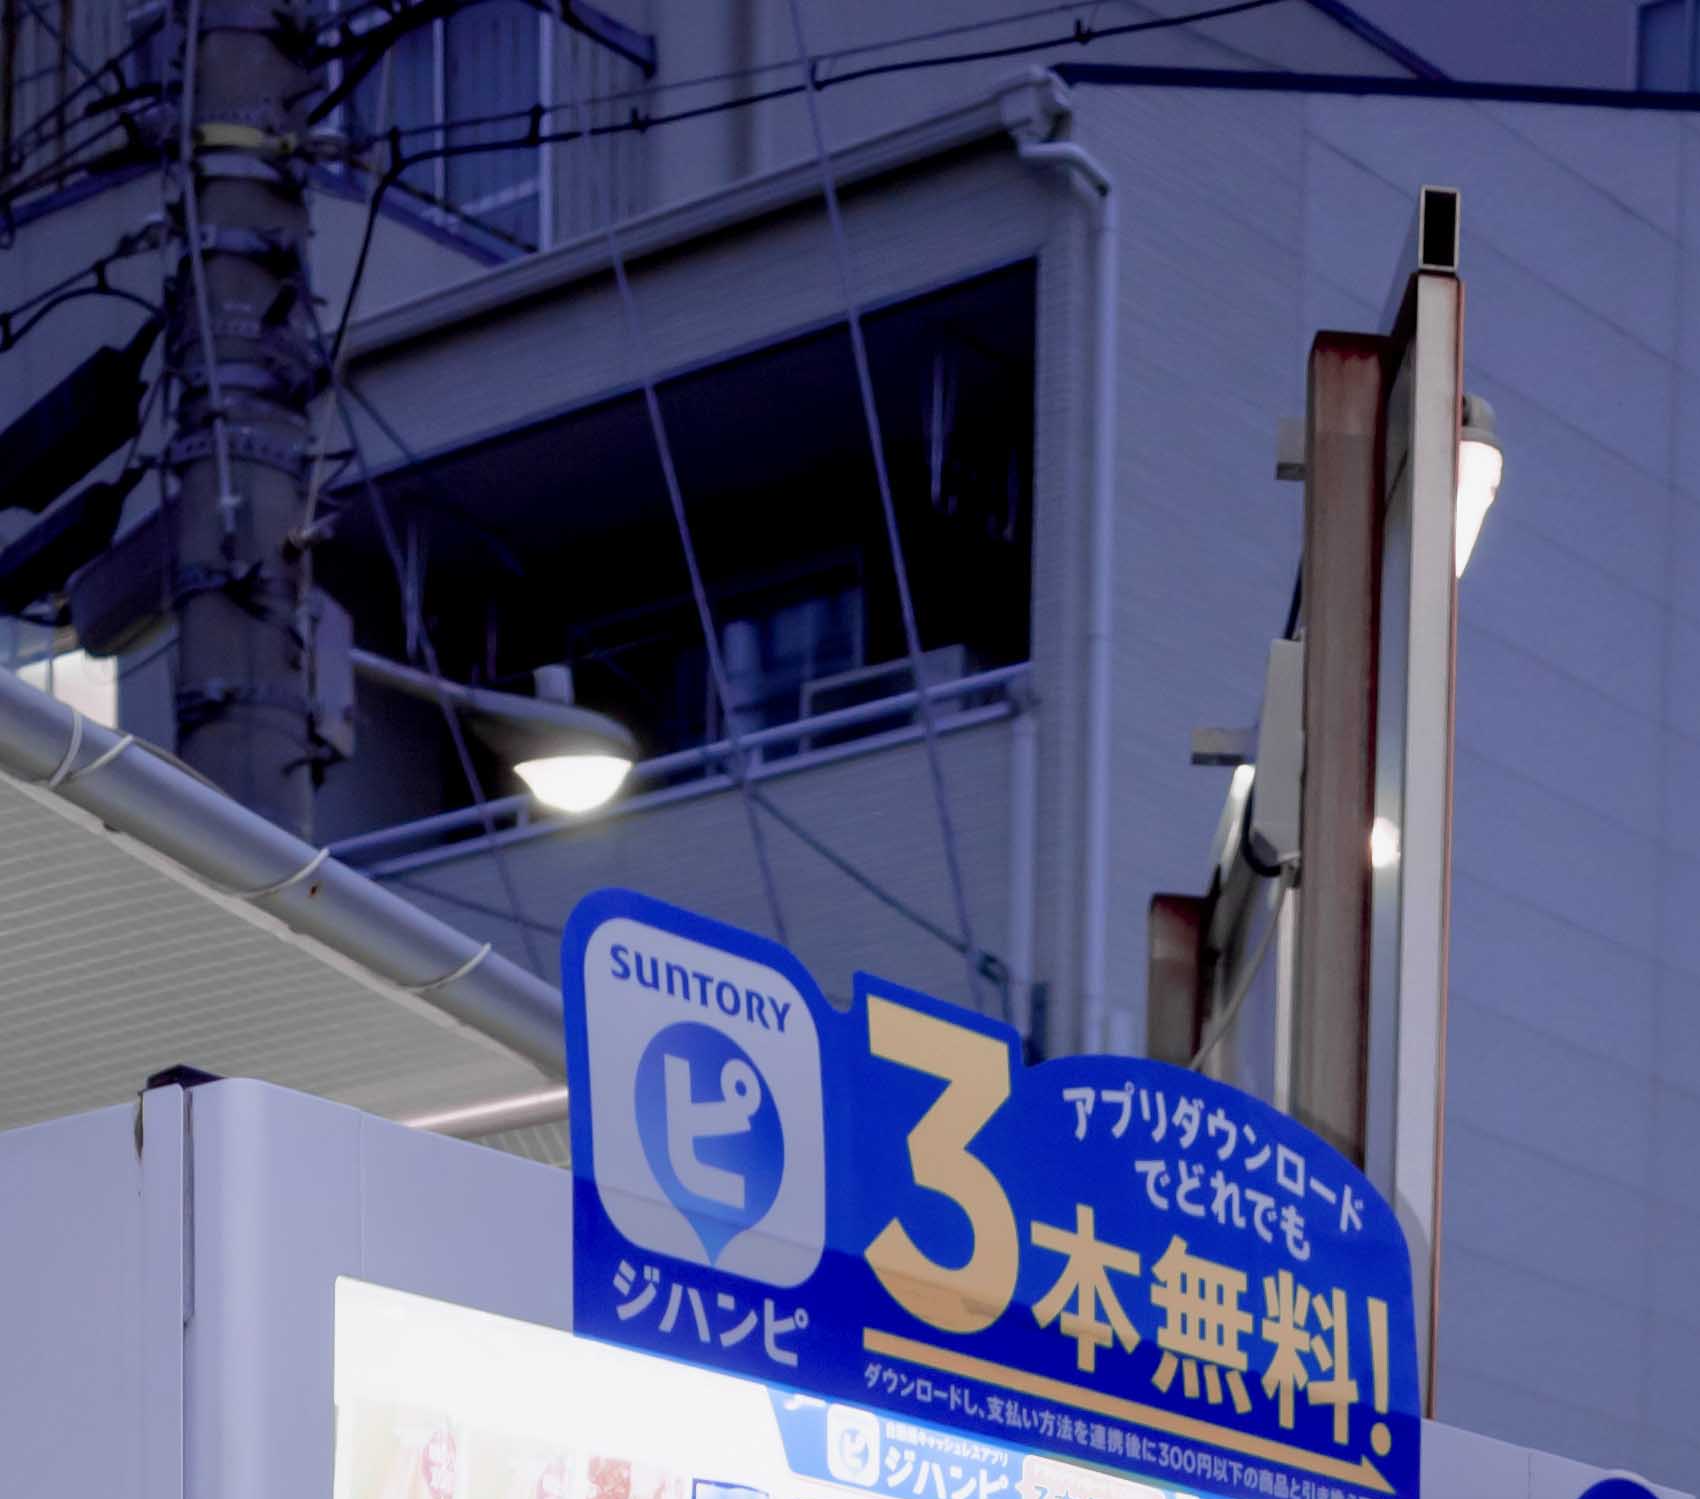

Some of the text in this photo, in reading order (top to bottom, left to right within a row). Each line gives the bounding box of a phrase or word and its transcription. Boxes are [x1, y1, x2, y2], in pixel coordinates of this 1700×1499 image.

[609, 942, 792, 1034] SUNTORY
[1063, 1086, 1366, 1231] アプリダウンロード
[1134, 1157, 1312, 1261] でどれでも
[611, 1262, 810, 1368] ジハンピ
